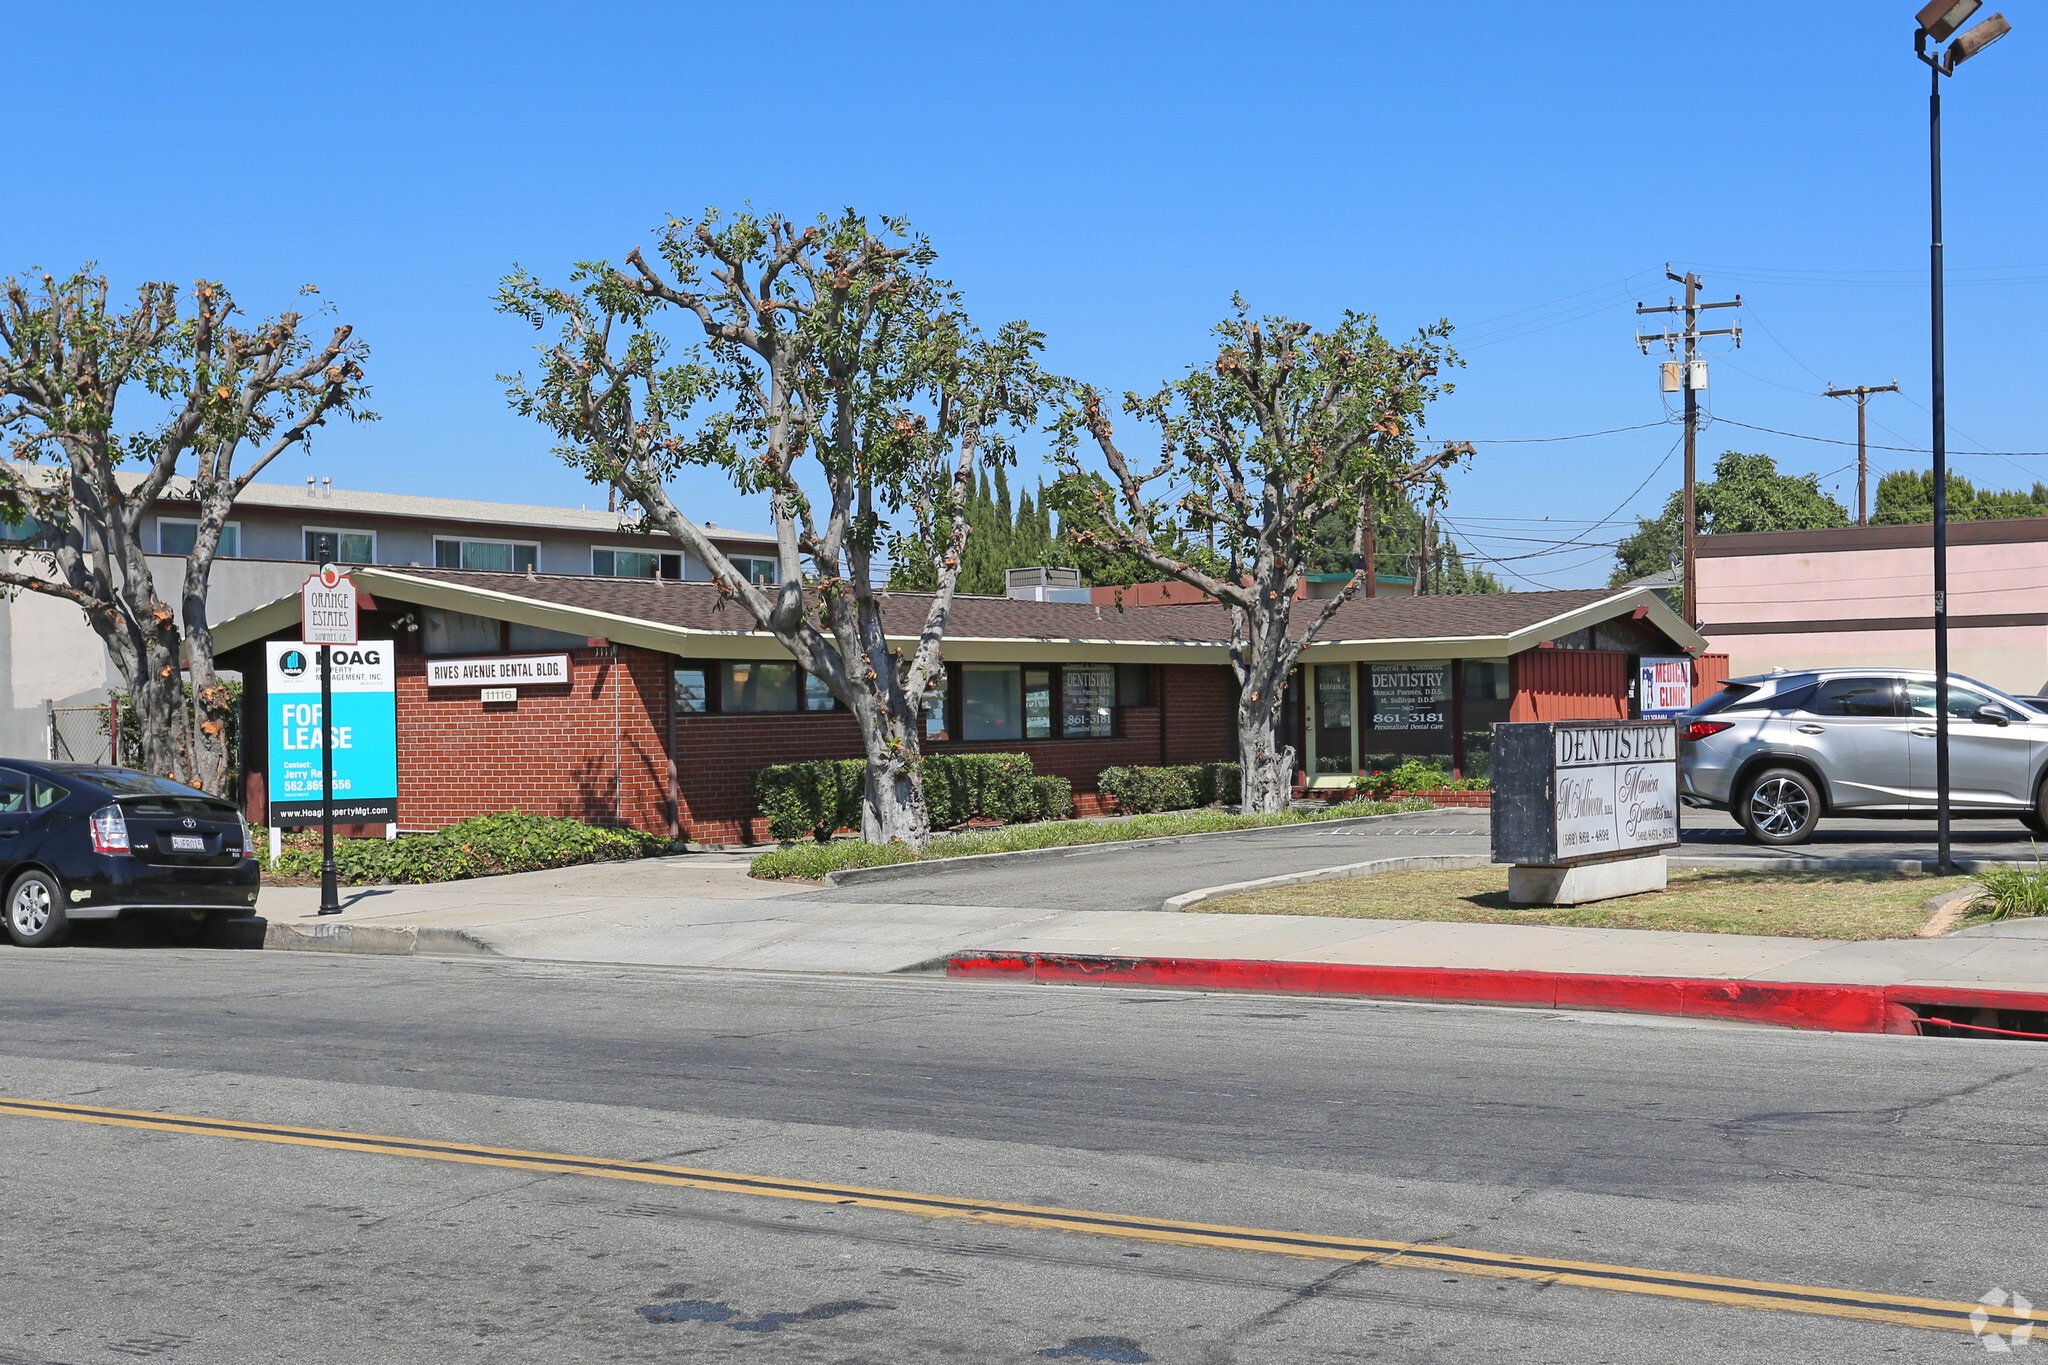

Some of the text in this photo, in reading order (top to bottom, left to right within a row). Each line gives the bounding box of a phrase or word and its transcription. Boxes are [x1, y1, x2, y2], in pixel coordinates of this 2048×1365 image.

[311, 592, 349, 609] ORANGE
[312, 611, 349, 627] ESTATES
[434, 662, 562, 679] RIVES AVENUE DENTAL BLDG.
[1655, 662, 1689, 683] MEDICAL
[1067, 672, 1111, 687] DENTISTRY
[1371, 672, 1444, 688] DENTISTRY
[484, 690, 513, 699] 11116
[1659, 686, 1686, 707] CLINIC
[1067, 714, 1111, 724] 861-3181
[1373, 713, 1445, 723] 861-3181
[1561, 727, 1668, 764] DENTISTRY
[283, 761, 312, 769] Contact:
[284, 769, 337, 780] Jerry Res
[284, 779, 351, 791] 562.869556
[1618, 766, 1659, 803] Monica
[1562, 832, 1578, 848] (562)
